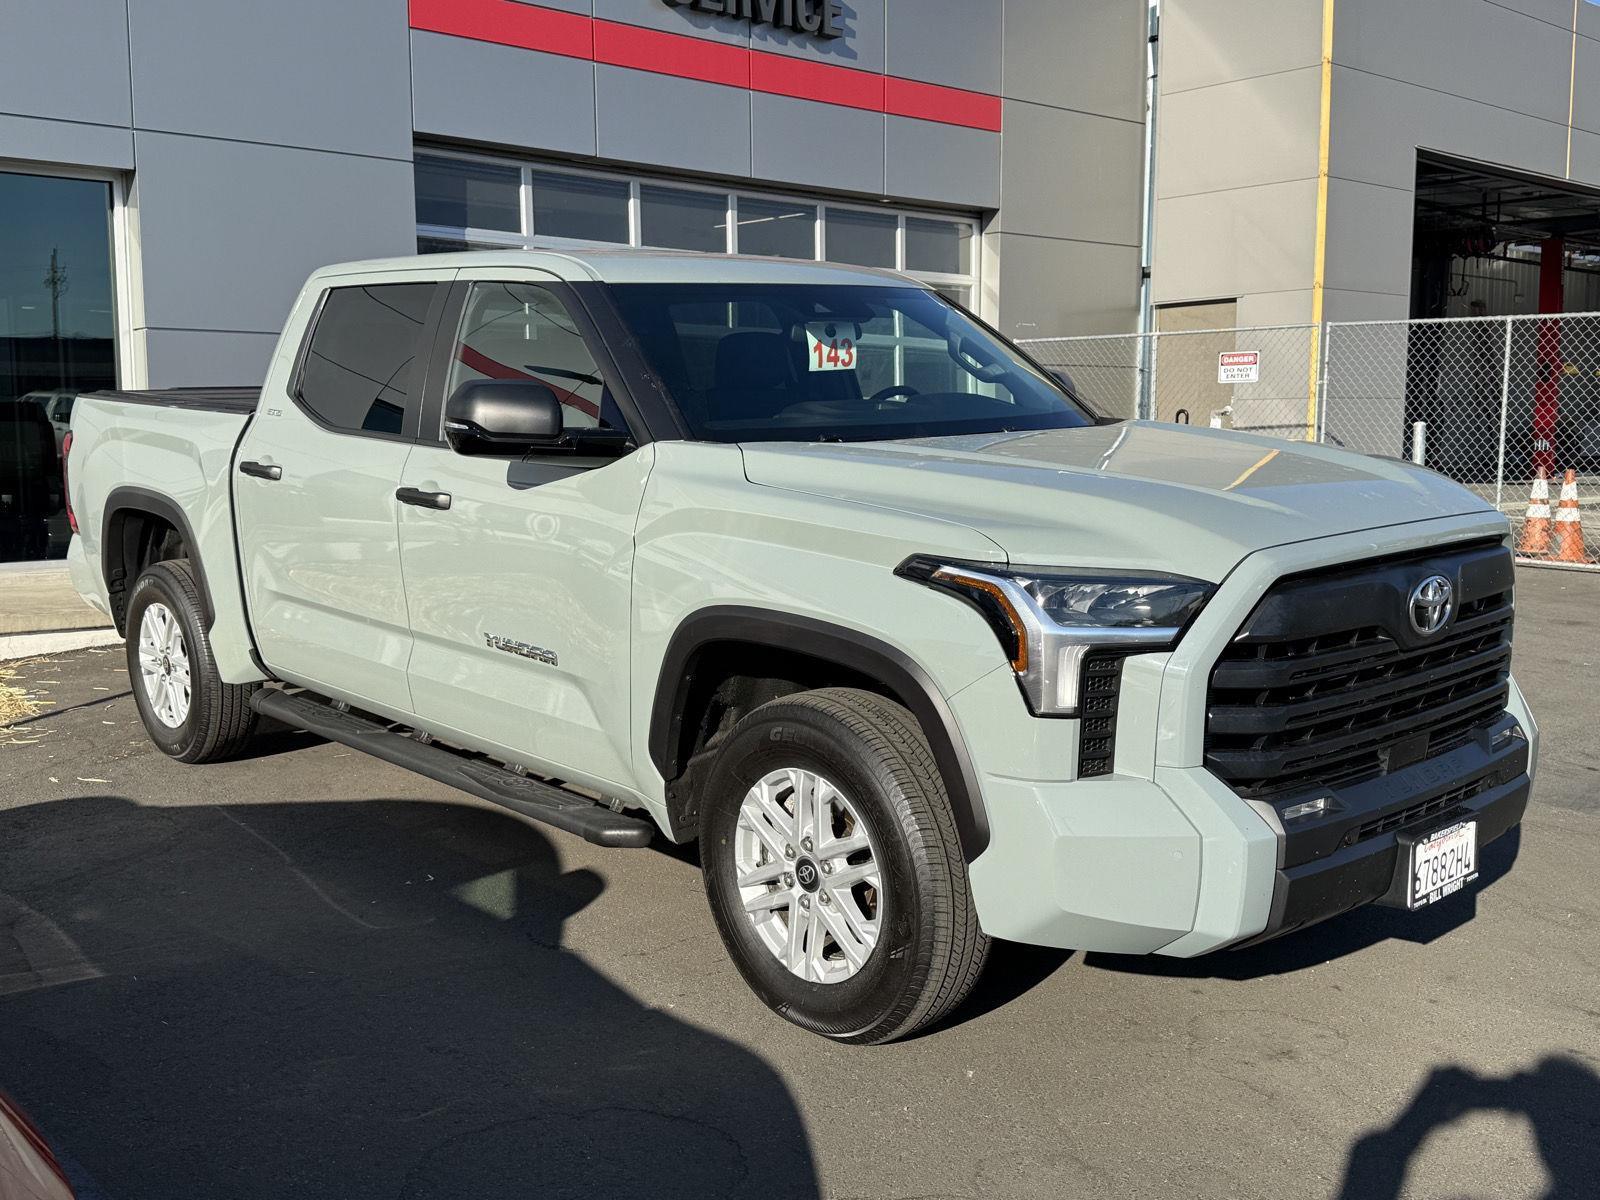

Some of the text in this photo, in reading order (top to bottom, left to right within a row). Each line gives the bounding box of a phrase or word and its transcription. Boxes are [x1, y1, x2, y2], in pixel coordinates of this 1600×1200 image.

[813, 338, 853, 368] 143
[1223, 355, 1255, 363] DANGER
[483, 631, 558, 667] TUNDRA
[1429, 888, 1442, 905] BILL
[1442, 877, 1464, 898] WRIGHT
